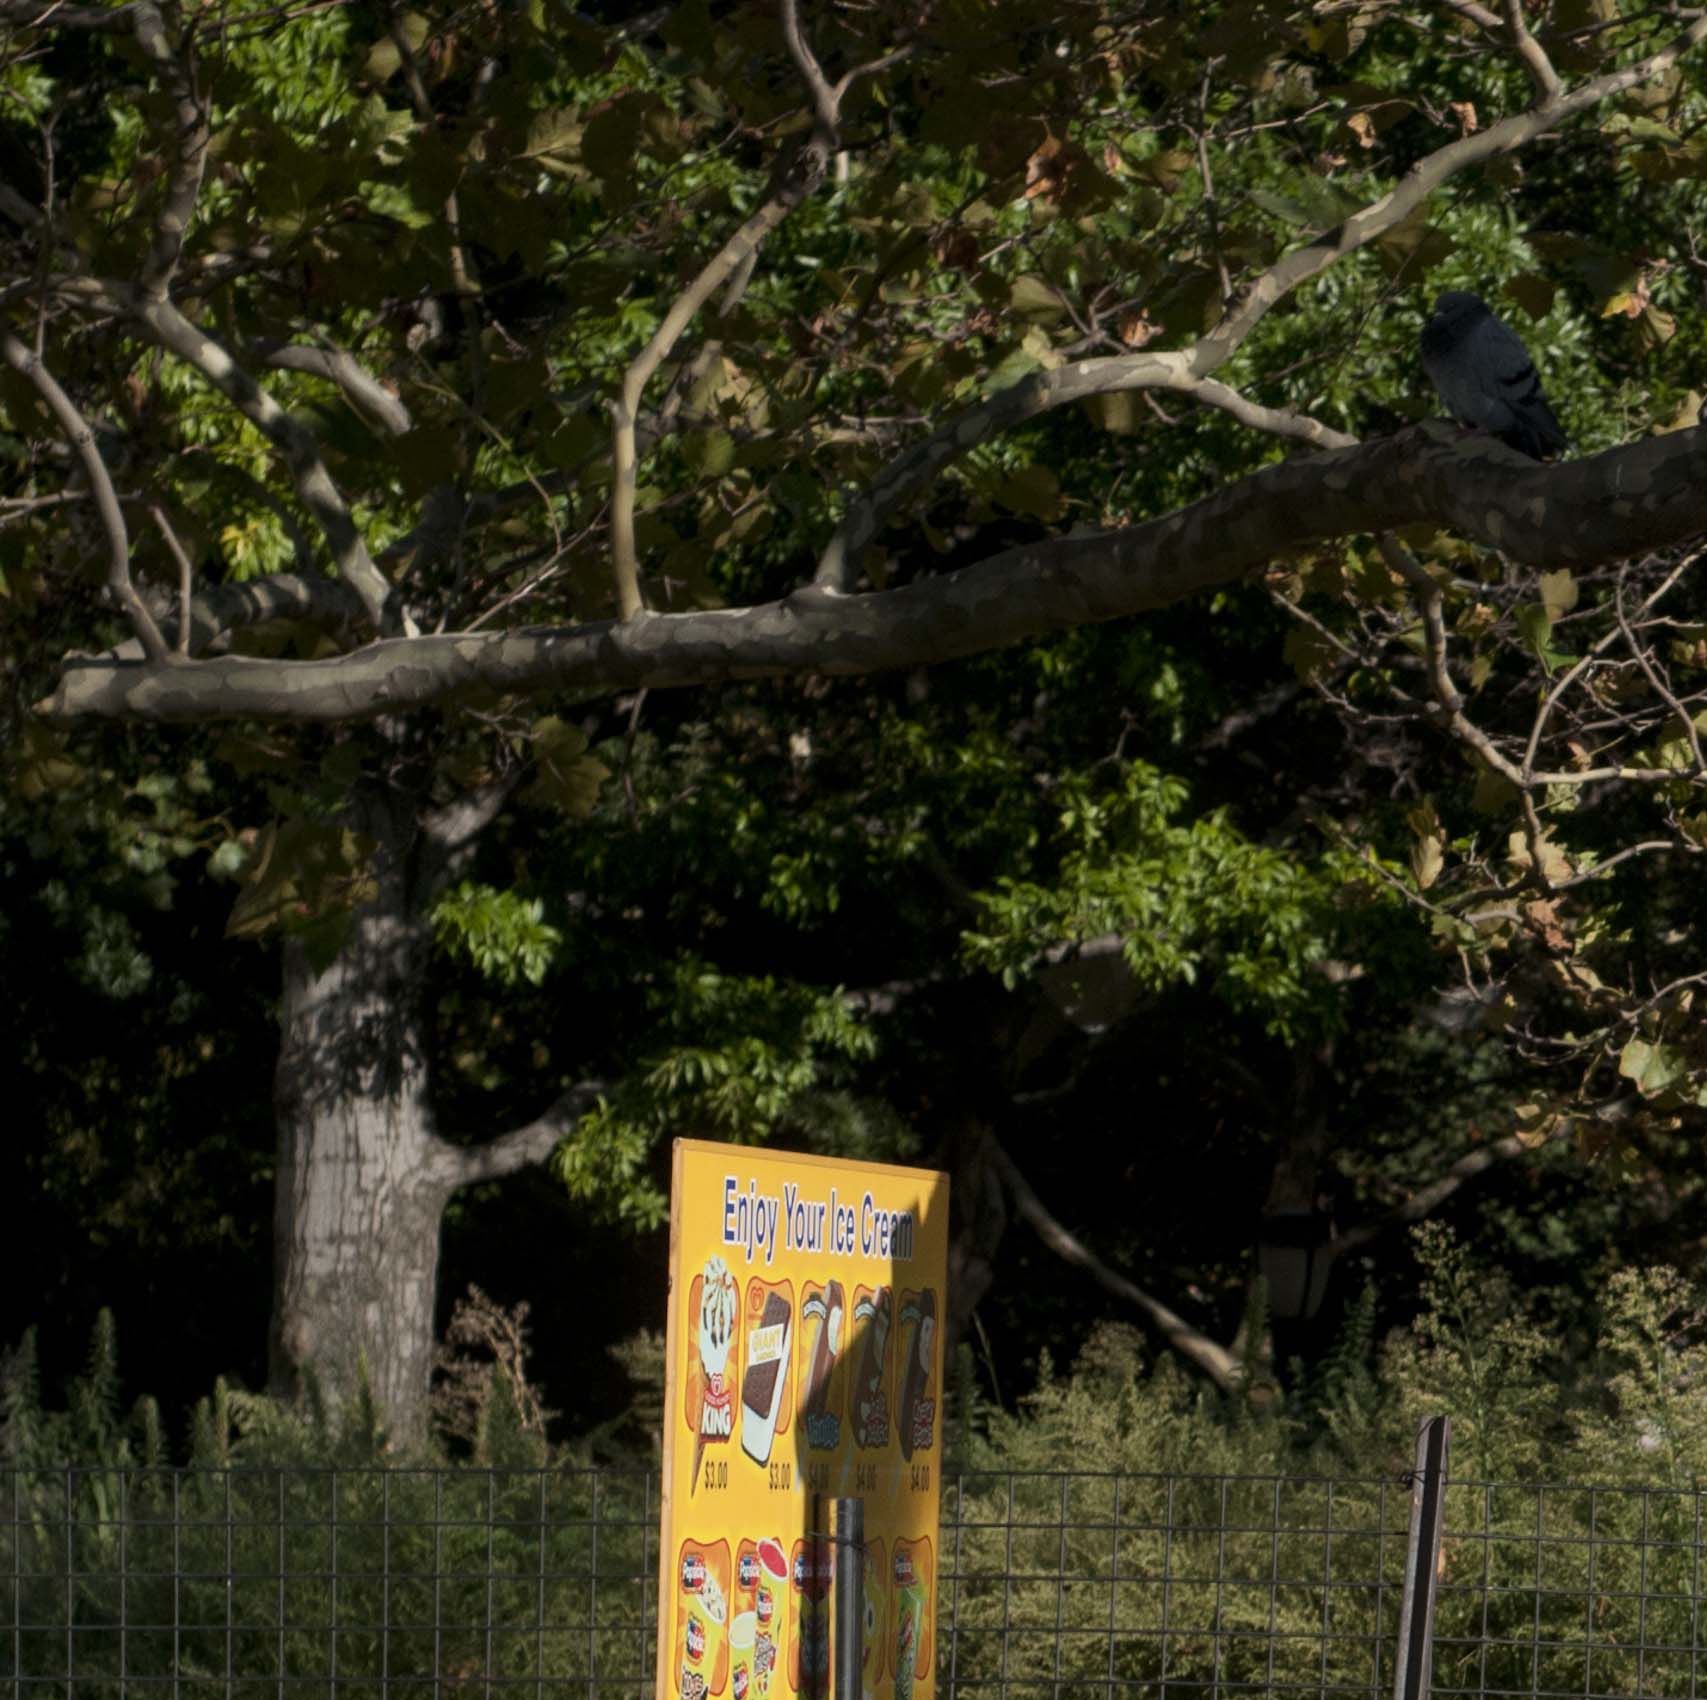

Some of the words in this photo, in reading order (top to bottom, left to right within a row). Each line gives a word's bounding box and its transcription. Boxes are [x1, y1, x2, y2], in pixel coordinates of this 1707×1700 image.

[723, 1175, 779, 1264] Enjoy
[783, 1182, 826, 1252] Your
[830, 1188, 856, 1256] Ice
[860, 1191, 913, 1260] Cream
[701, 1402, 731, 1436] KING
[705, 1461, 728, 1489] $3.00
[769, 1463, 791, 1490] $3.00
